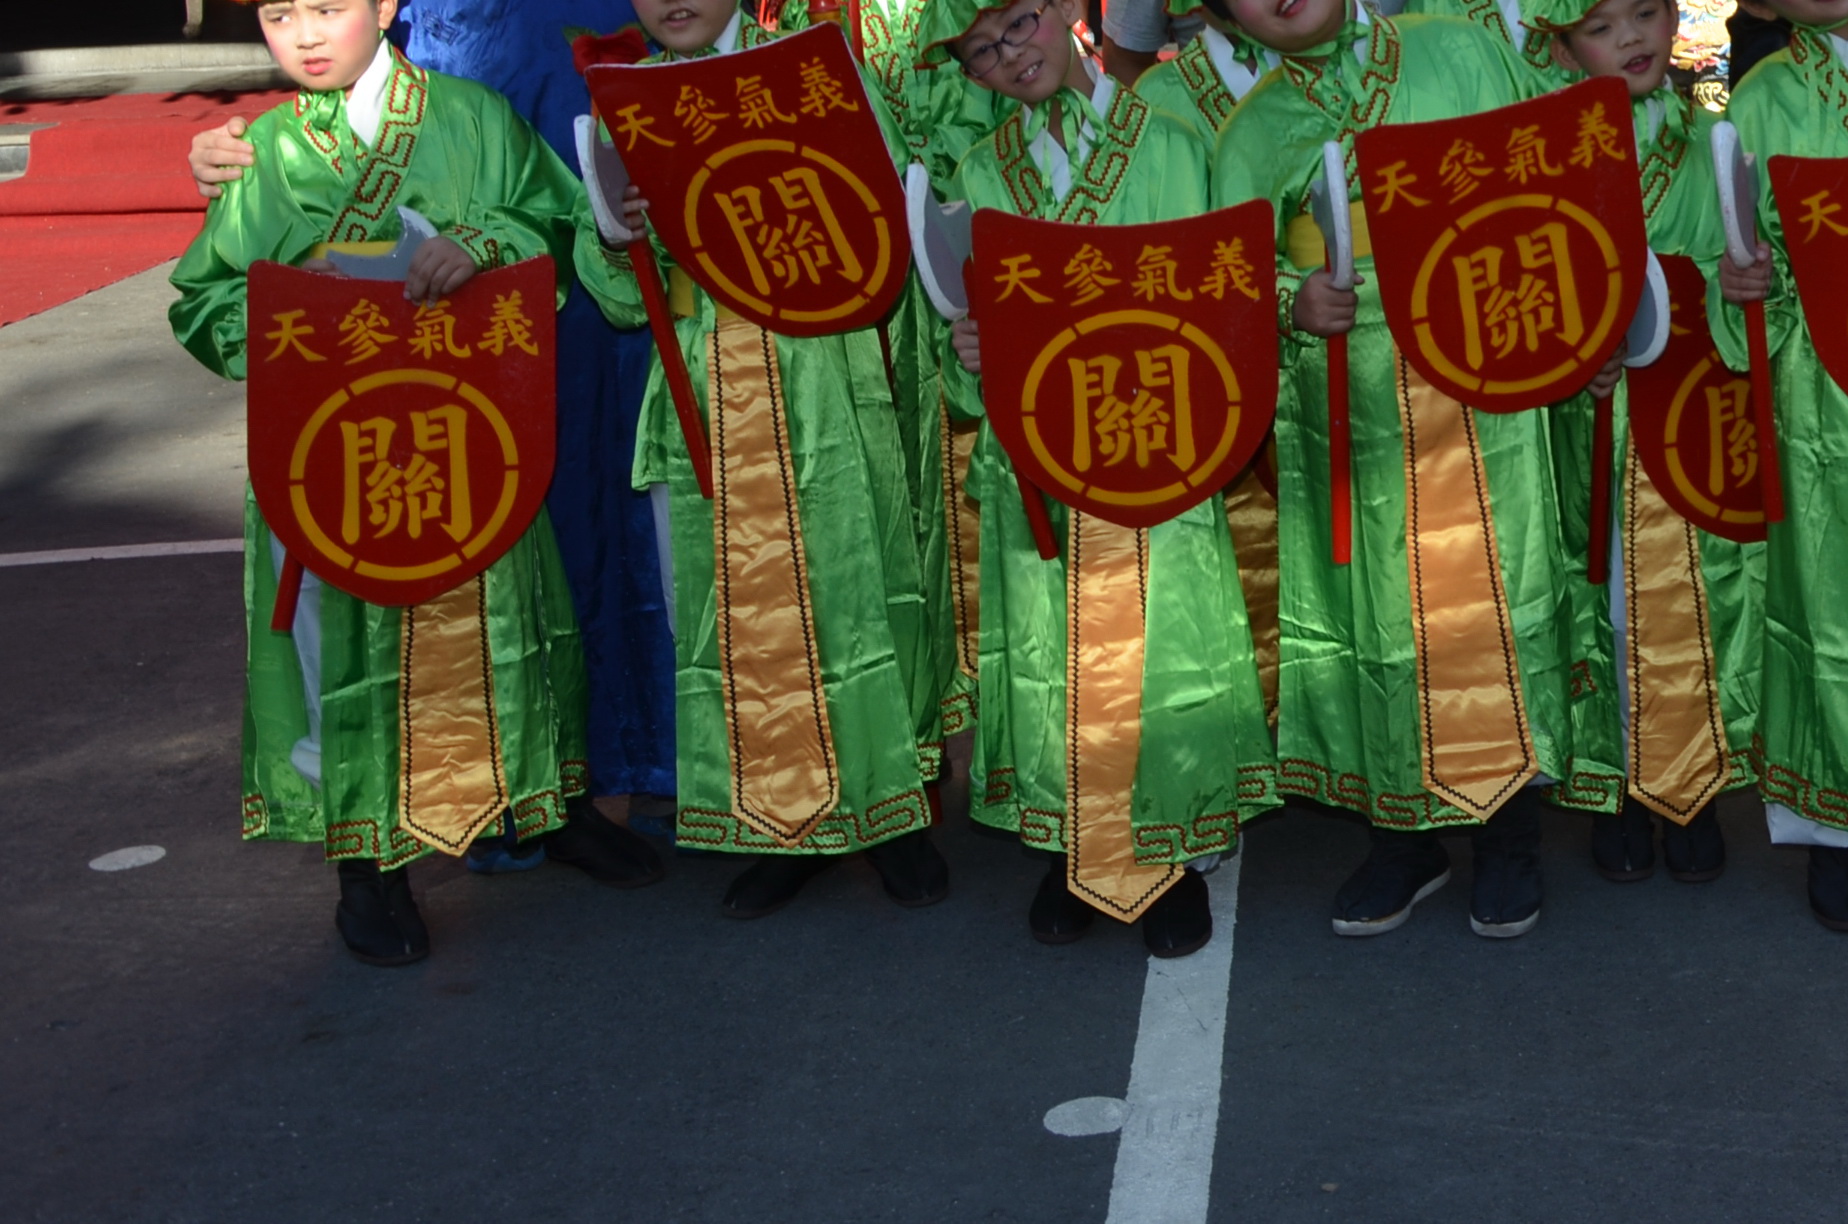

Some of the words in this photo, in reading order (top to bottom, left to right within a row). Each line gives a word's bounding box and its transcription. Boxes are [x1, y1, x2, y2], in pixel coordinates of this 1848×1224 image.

[713, 167, 864, 297] 關
[1452, 222, 1585, 371] 關
[340, 404, 472, 545] 關
[1068, 344, 1200, 474] 關
